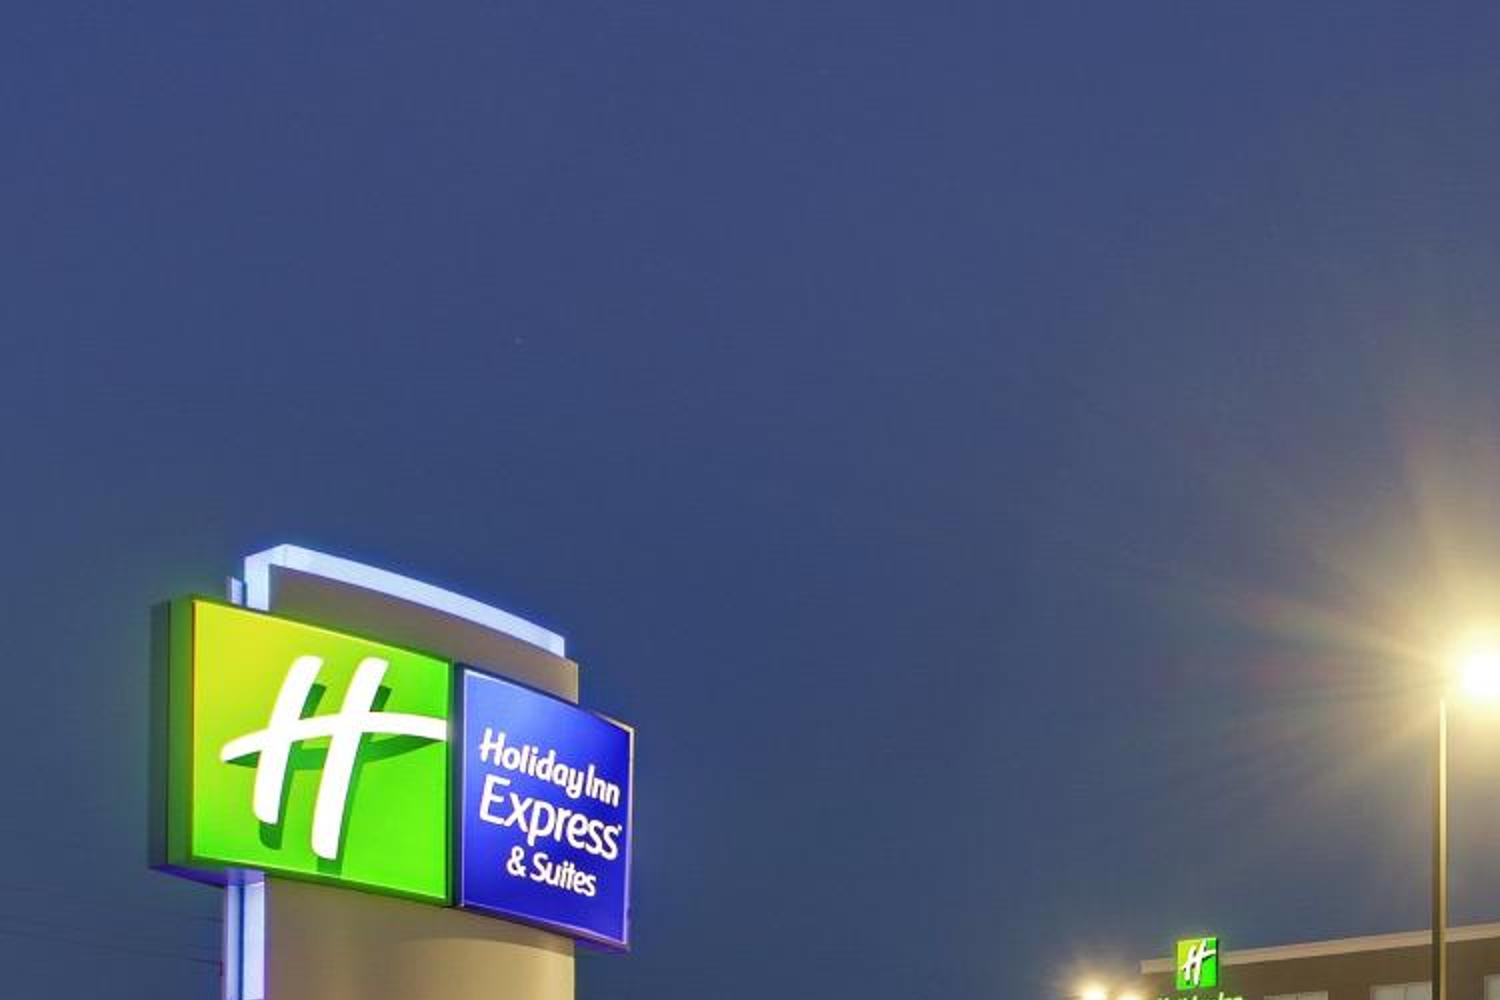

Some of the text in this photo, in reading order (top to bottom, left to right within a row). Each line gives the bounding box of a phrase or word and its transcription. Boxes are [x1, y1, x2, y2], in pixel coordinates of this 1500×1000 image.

[479, 727, 621, 808] Holiday Inn
[479, 773, 620, 861] Express
[506, 845, 598, 897] & Suites
